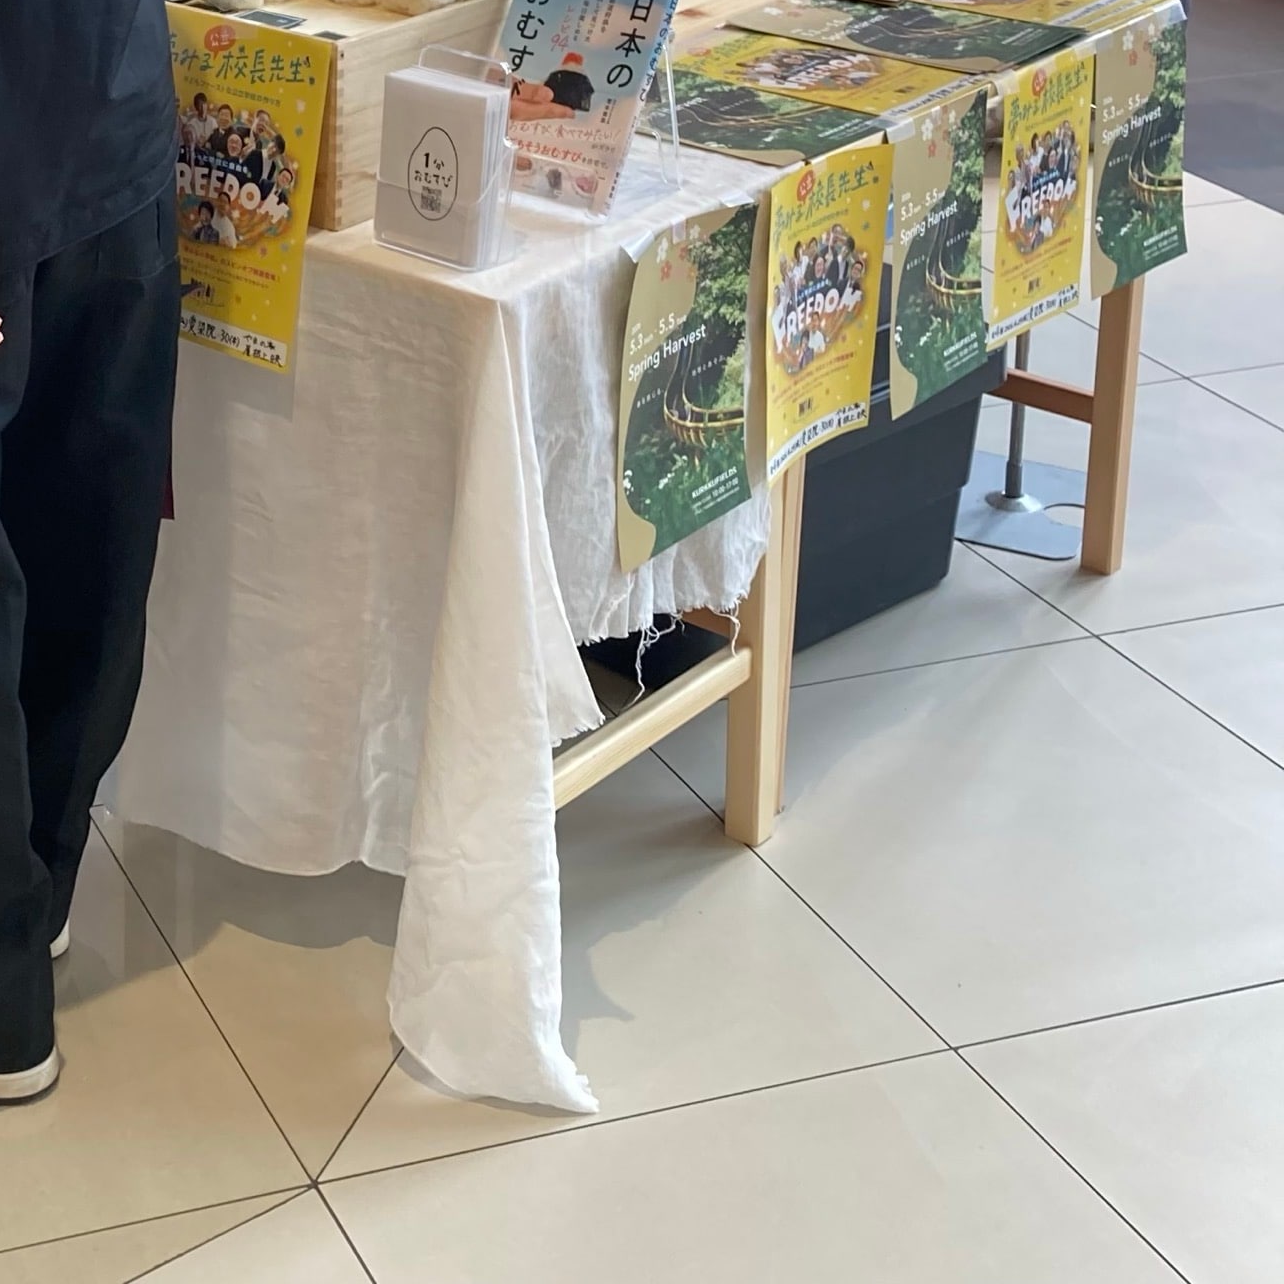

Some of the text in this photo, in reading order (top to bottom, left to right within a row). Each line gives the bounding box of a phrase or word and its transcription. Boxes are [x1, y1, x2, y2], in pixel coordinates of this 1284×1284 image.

[1102, 122, 1129, 146] Spring
[1130, 105, 1161, 131] Harvest
[414, 169, 454, 188] おむすび
[424, 152, 444, 171] 1分
[177, 161, 290, 225] REEDOM
[900, 187, 938, 221] 5.3 5.5
[1005, 177, 1078, 233] FREEDOM
[899, 220, 926, 247] Spring
[927, 199, 958, 229] Harvest
[629, 333, 644, 356] 5.3
[659, 312, 676, 335] 5.5
[771, 287, 864, 355] FREEDOM
[627, 349, 661, 383] Spring
[663, 323, 707, 359] Harvest
